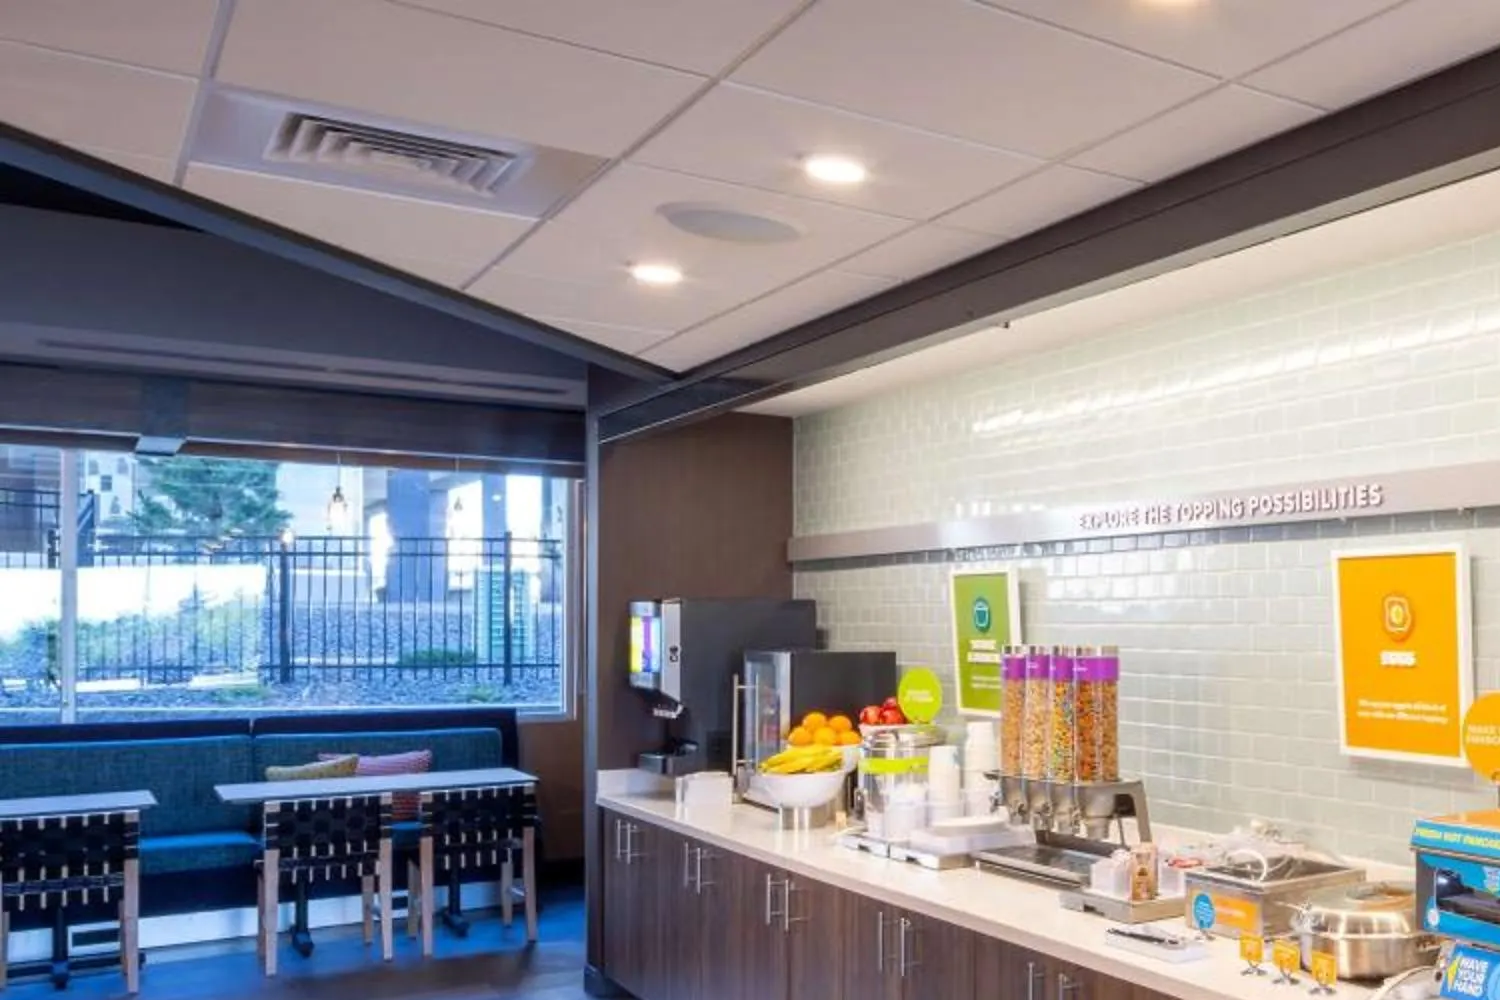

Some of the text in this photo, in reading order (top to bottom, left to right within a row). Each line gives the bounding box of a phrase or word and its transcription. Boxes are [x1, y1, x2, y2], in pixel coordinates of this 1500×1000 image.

[1079, 484, 1382, 529] EXPLORE THE TOPPING POSSIBILITIES
[1460, 956, 1489, 973] WAVE
[1457, 968, 1486, 985] YOUR
[1453, 979, 1484, 998] HAND
